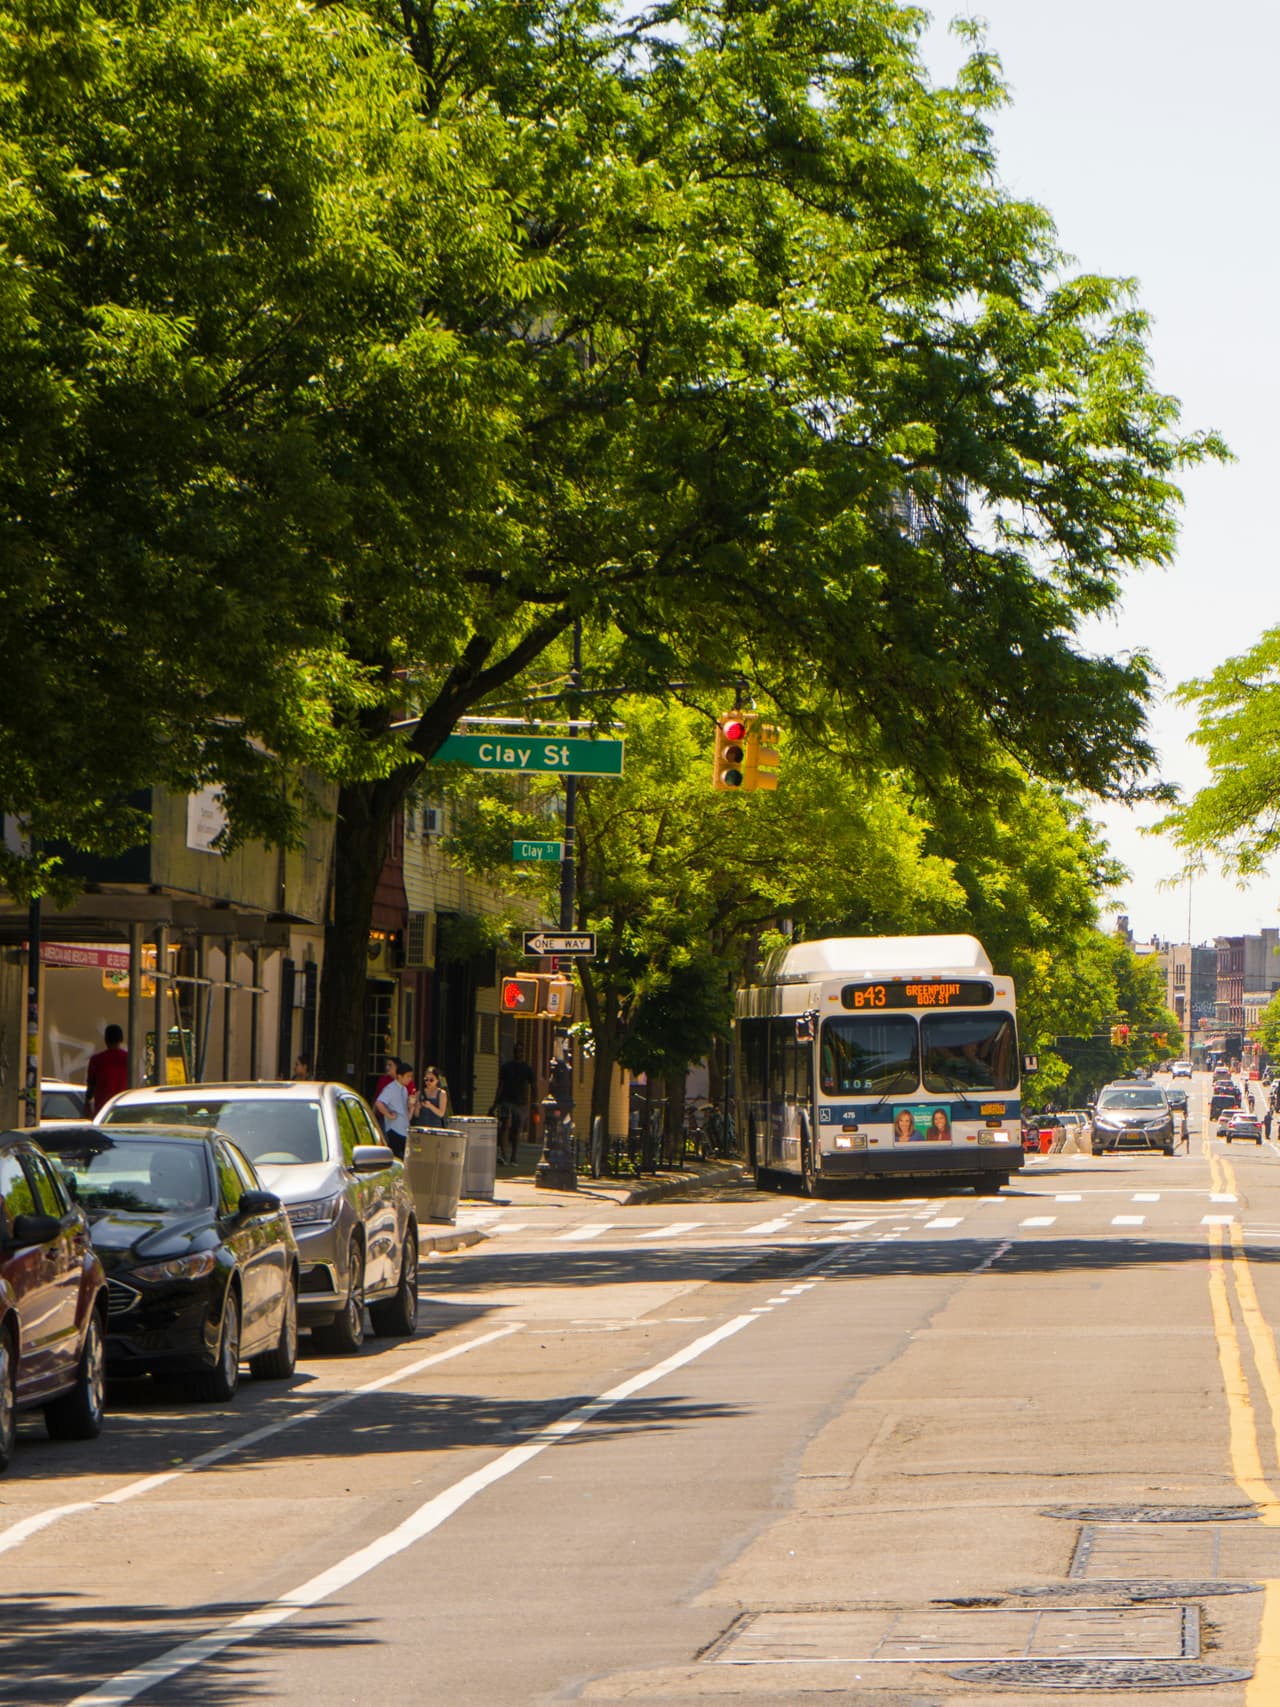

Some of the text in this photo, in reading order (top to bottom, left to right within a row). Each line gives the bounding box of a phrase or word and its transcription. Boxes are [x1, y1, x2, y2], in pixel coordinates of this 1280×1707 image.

[479, 744, 570, 767] Clay St
[521, 844, 543, 859] Clay
[534, 940, 586, 949] ONE WAY
[854, 984, 961, 1007] B43 GREENPOINT
[917, 994, 951, 1005] BOX ST
